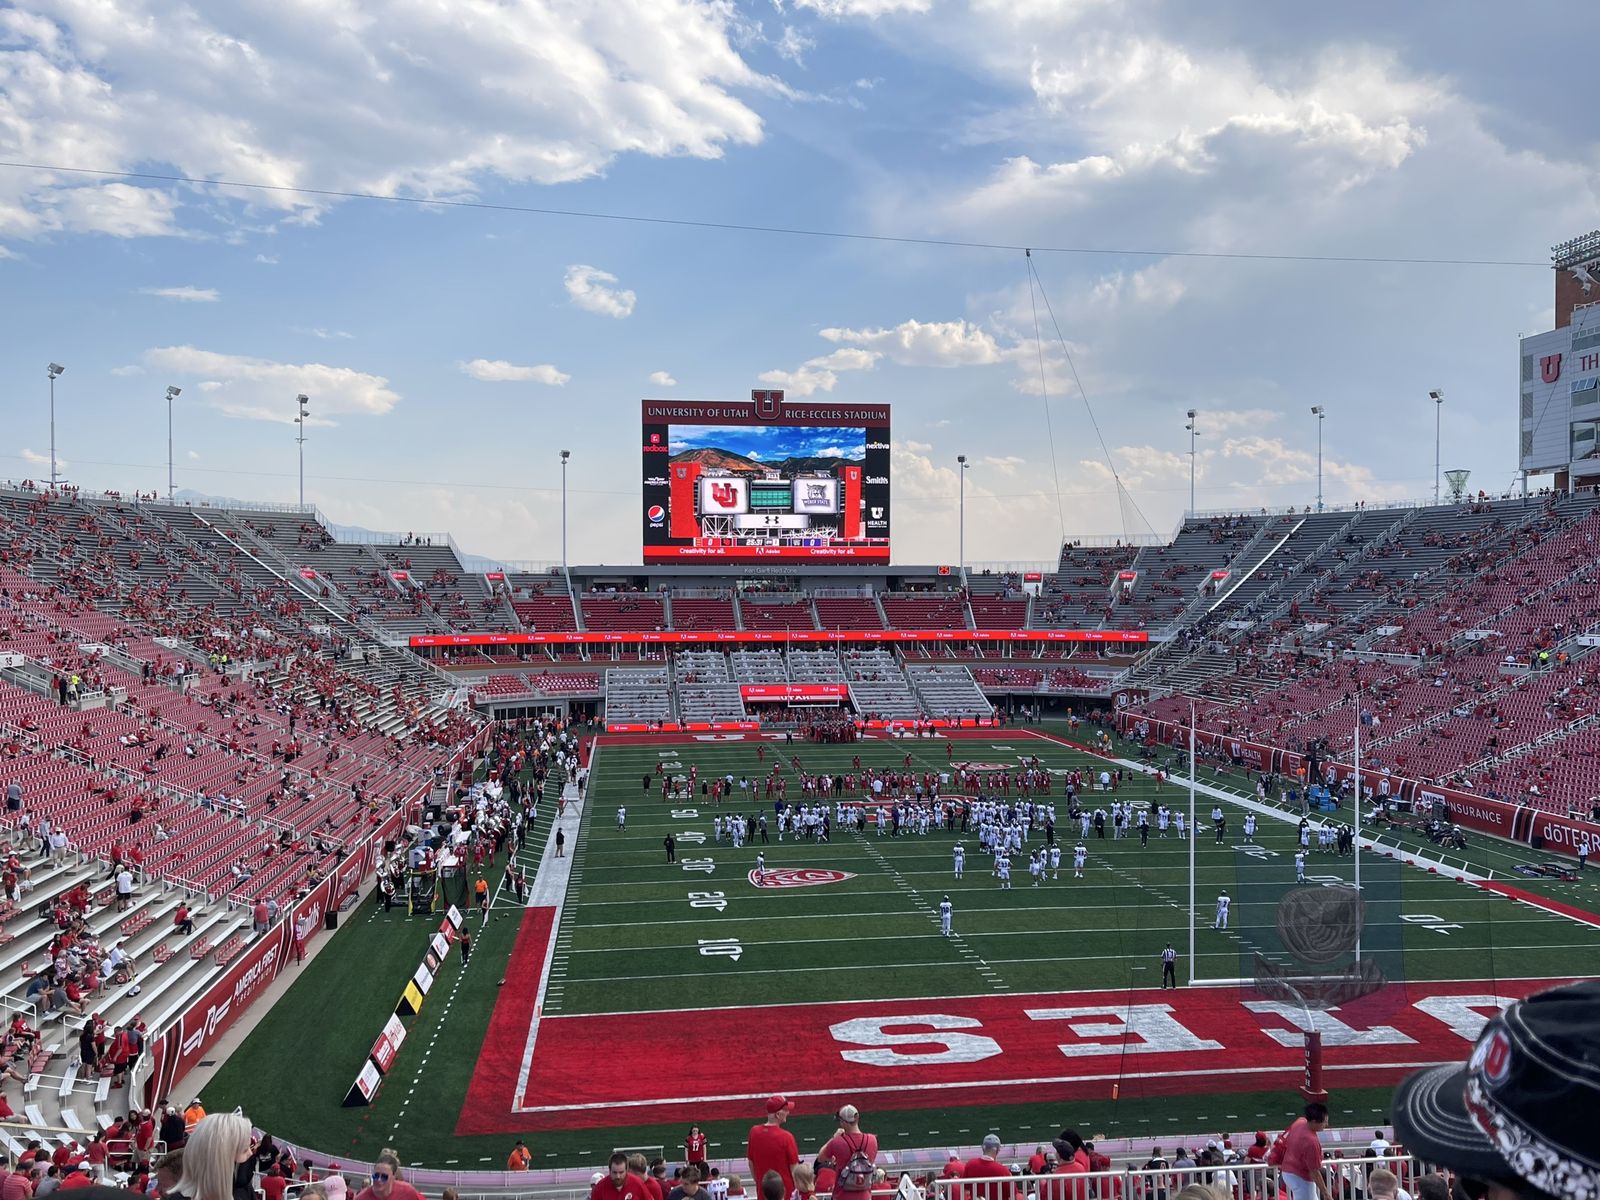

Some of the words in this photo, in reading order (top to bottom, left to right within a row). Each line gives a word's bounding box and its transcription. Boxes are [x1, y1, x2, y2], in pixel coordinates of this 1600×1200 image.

[1539, 353, 1562, 384] U
[752, 390, 784, 420] U
[648, 407, 705, 417] UNIVERSITY
[707, 408, 719, 417] OF
[723, 409, 749, 418] UTAH
[785, 410, 841, 420] RICE-ECCLES
[844, 411, 887, 420] STADIUM
[866, 441, 889, 450] nextiva
[865, 475, 889, 484] Smith's
[679, 547, 706, 555] Creativity
[810, 547, 837, 555] Creativity
[1241, 749, 1262, 762] HEALTH
[681, 857, 716, 871] 30
[688, 891, 728, 908] 20
[697, 938, 743, 955] 10
[233, 960, 262, 1001] AMERICA
[261, 943, 279, 972] FIRST
[1304, 1050, 1312, 1088] UTAH
